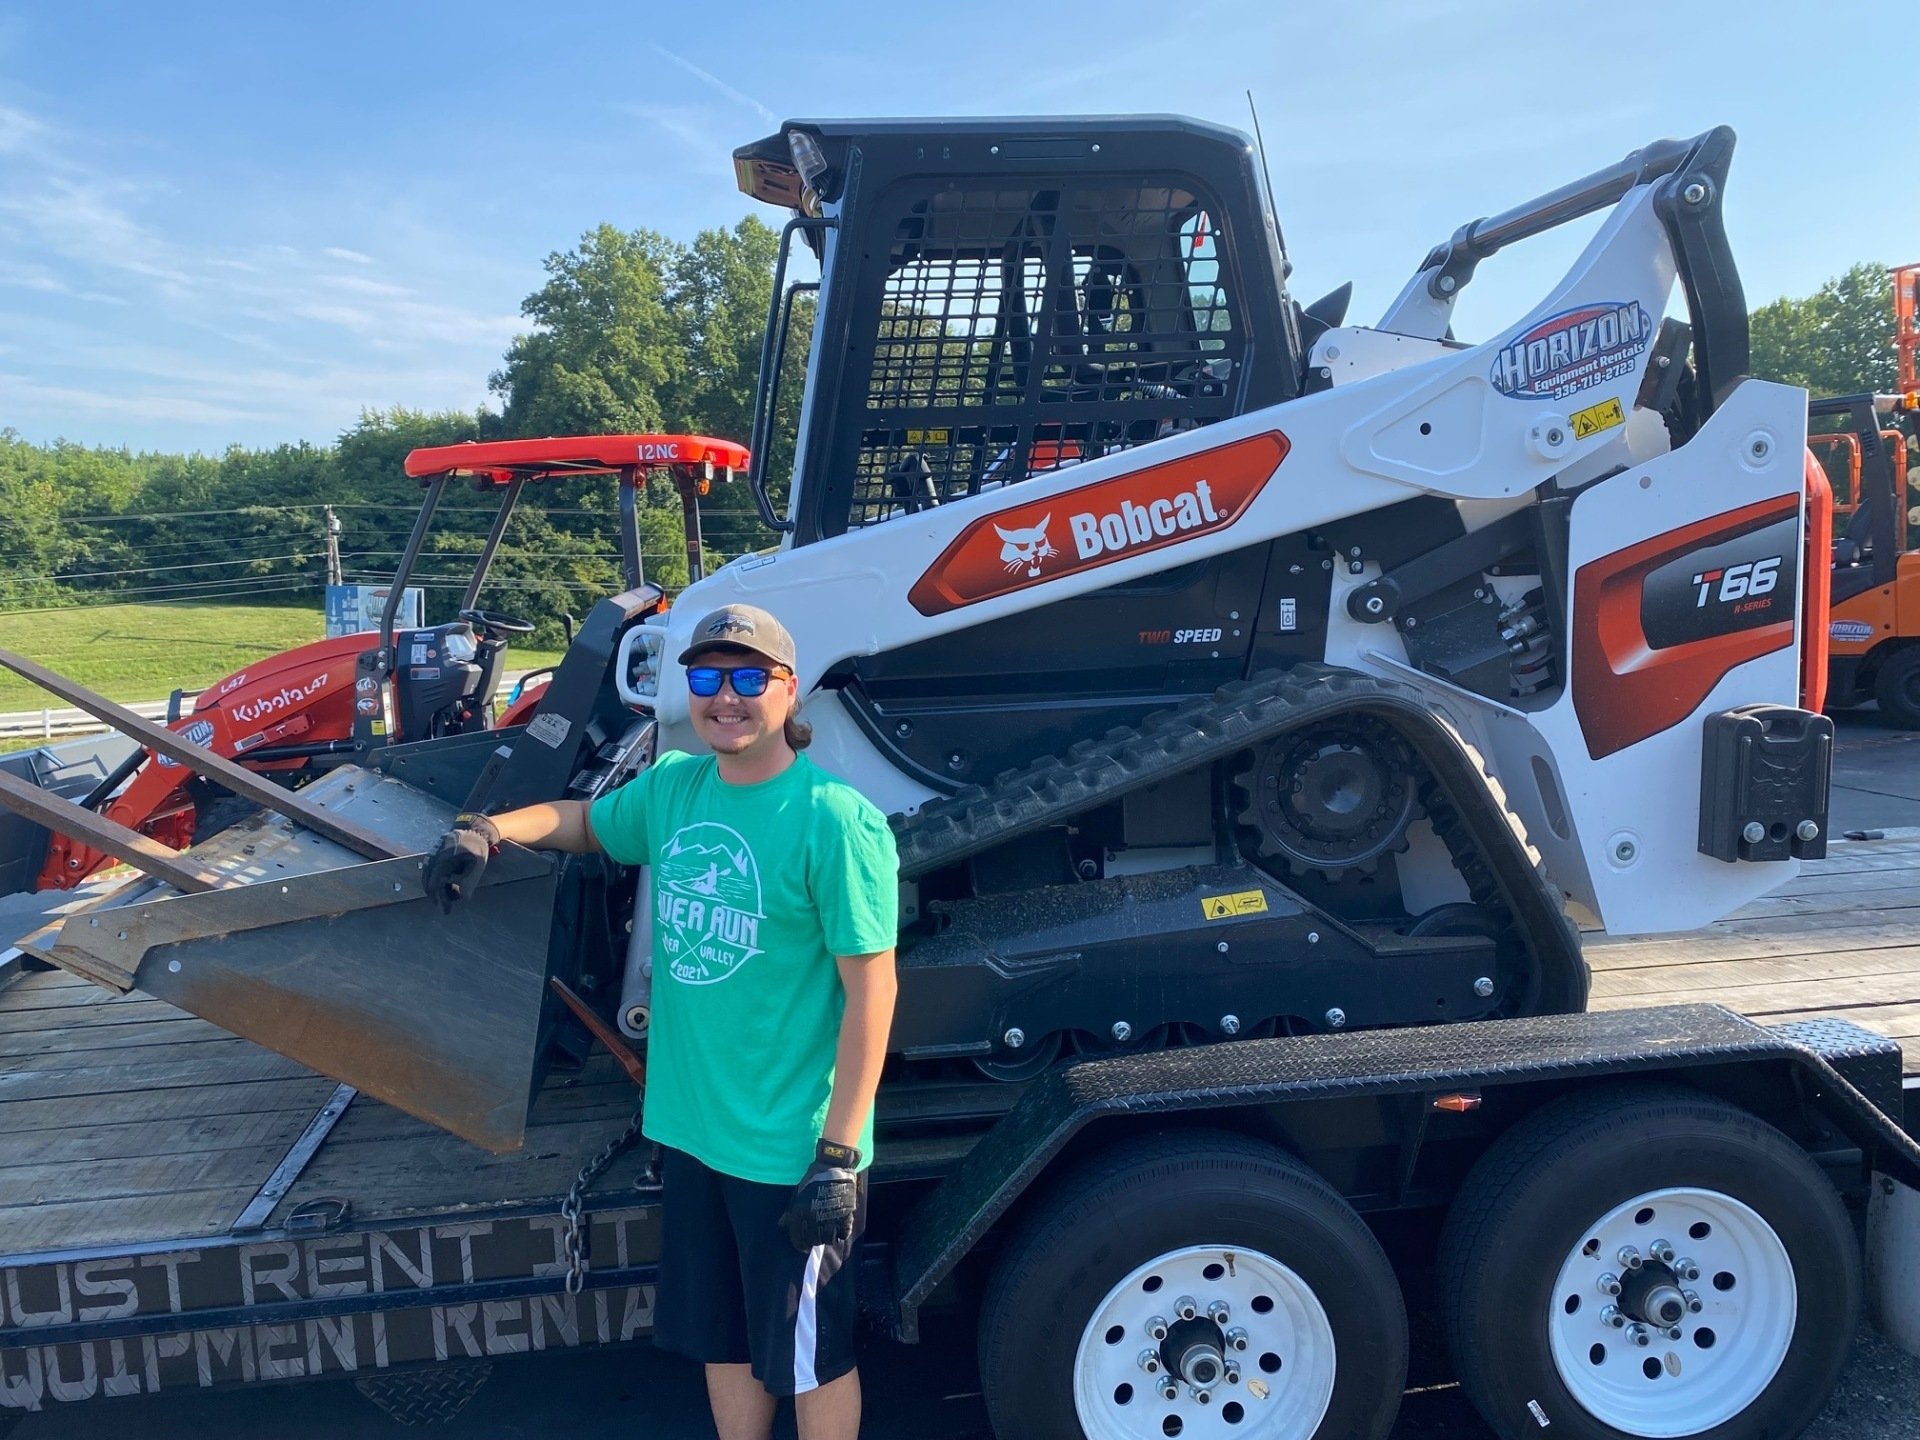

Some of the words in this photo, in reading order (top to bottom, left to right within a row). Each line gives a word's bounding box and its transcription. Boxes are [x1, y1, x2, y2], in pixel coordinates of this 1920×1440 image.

[1500, 301, 1642, 395] HORIZON
[1534, 359, 1599, 393] Equipment
[1599, 342, 1646, 367] Rentals
[1553, 358, 1636, 400] 336-719-2723
[637, 443, 679, 460] 12NC
[1069, 479, 1218, 560] Bobcat
[1692, 556, 1782, 608] T66
[1734, 598, 1773, 614] R-SERIES
[1139, 630, 1171, 644] TWO
[1173, 628, 1222, 644] SPEED
[221, 674, 247, 694] L47
[232, 688, 304, 722] Kubota
[304, 673, 328, 695] L47
[710, 906, 759, 948] RUN
[676, 964, 701, 981] 2021
[700, 945, 735, 967] VALLEY
[0, 1249, 200, 1327] UST
[239, 1221, 493, 1306] RENT
[529, 1207, 649, 1278] IT
